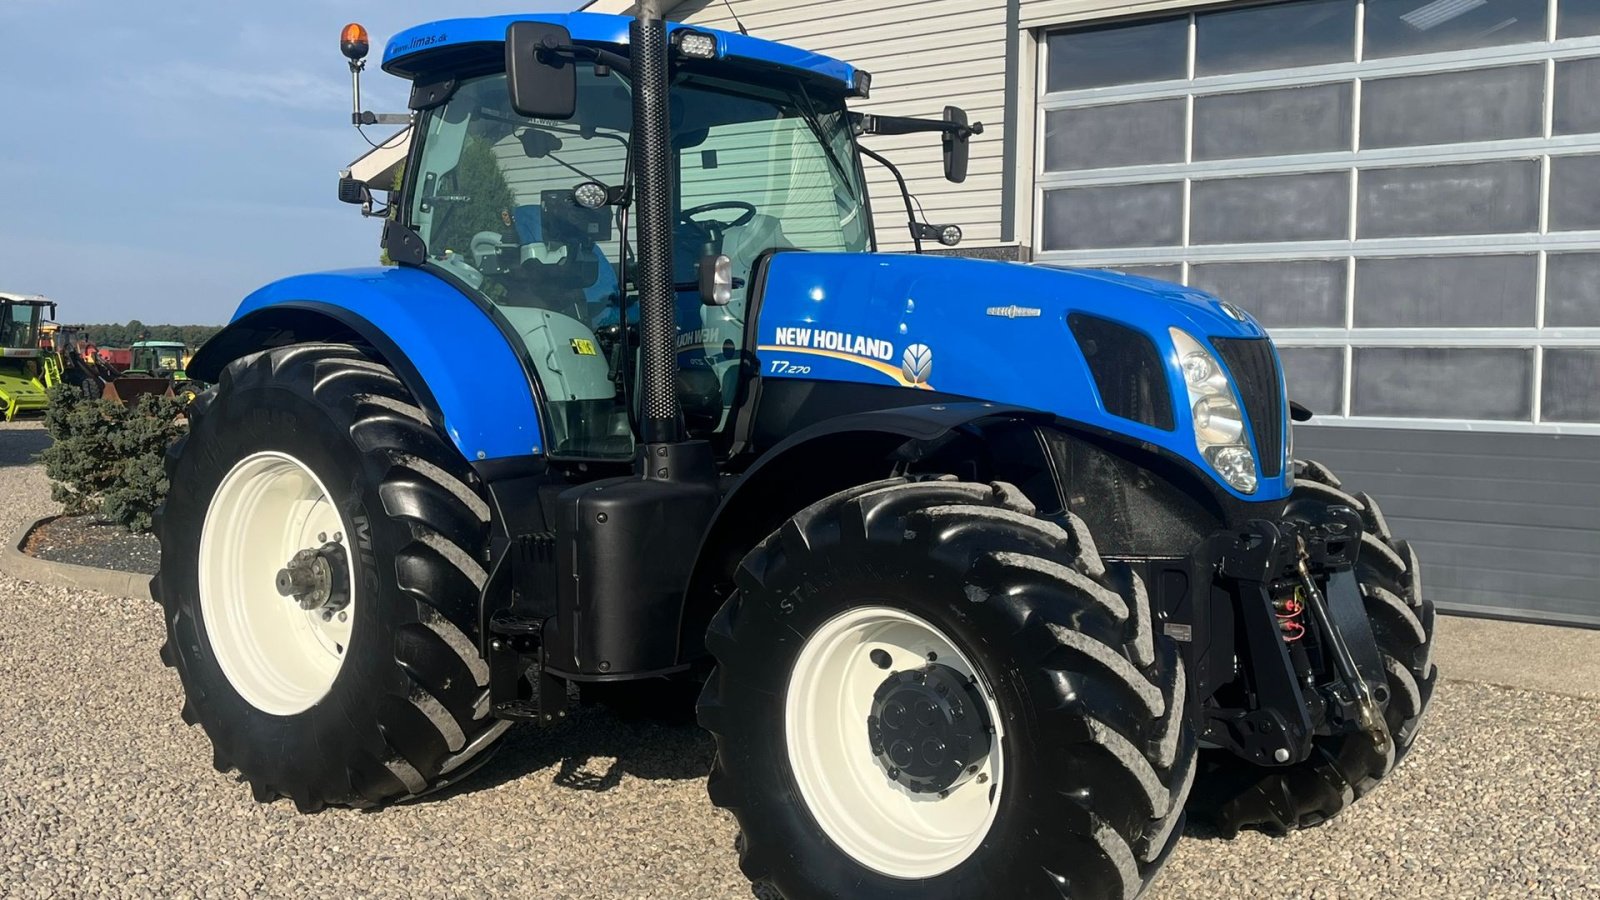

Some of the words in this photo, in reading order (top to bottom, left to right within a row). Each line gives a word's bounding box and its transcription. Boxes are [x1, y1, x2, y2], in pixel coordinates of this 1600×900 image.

[775, 326, 812, 347] NEW
[813, 329, 894, 361] HOLLAND
[770, 360, 811, 374] T7.270
